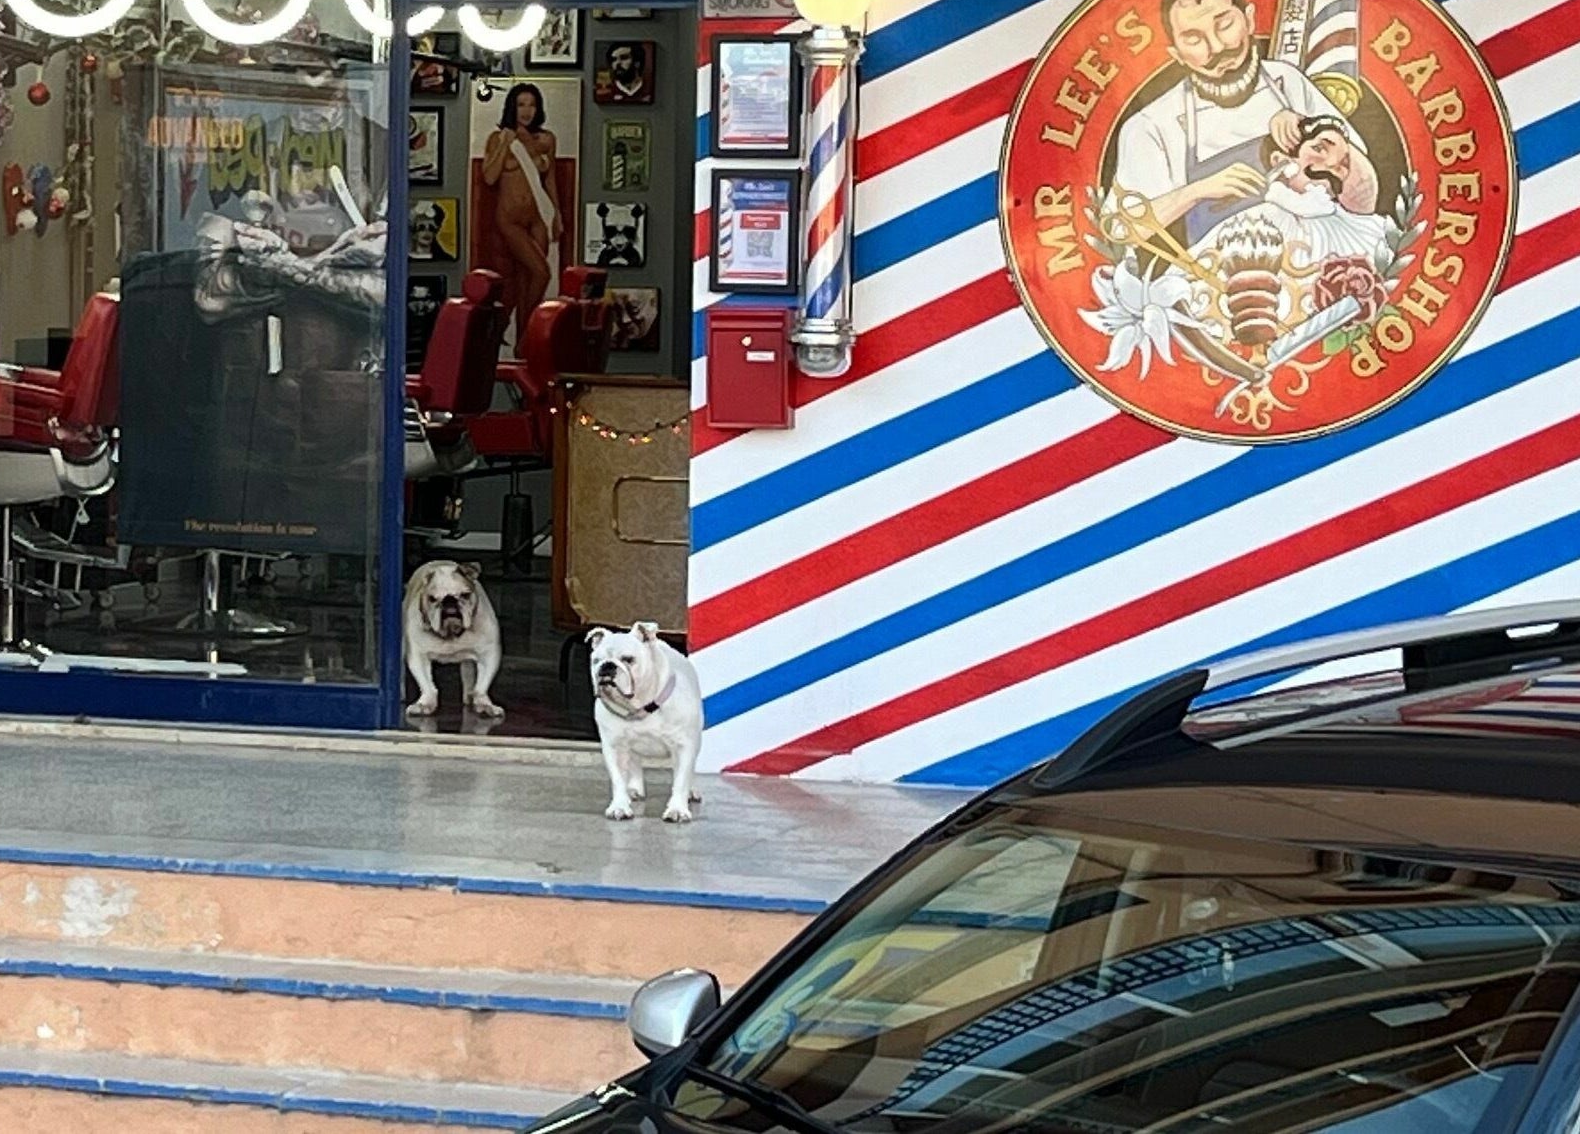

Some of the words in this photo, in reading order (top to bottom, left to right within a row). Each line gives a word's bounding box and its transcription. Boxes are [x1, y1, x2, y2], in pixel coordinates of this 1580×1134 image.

[1040, 8, 1155, 153] LEE'S
[1033, 183, 1087, 279] MR
[1349, 16, 1482, 379] BARBERSHOP
